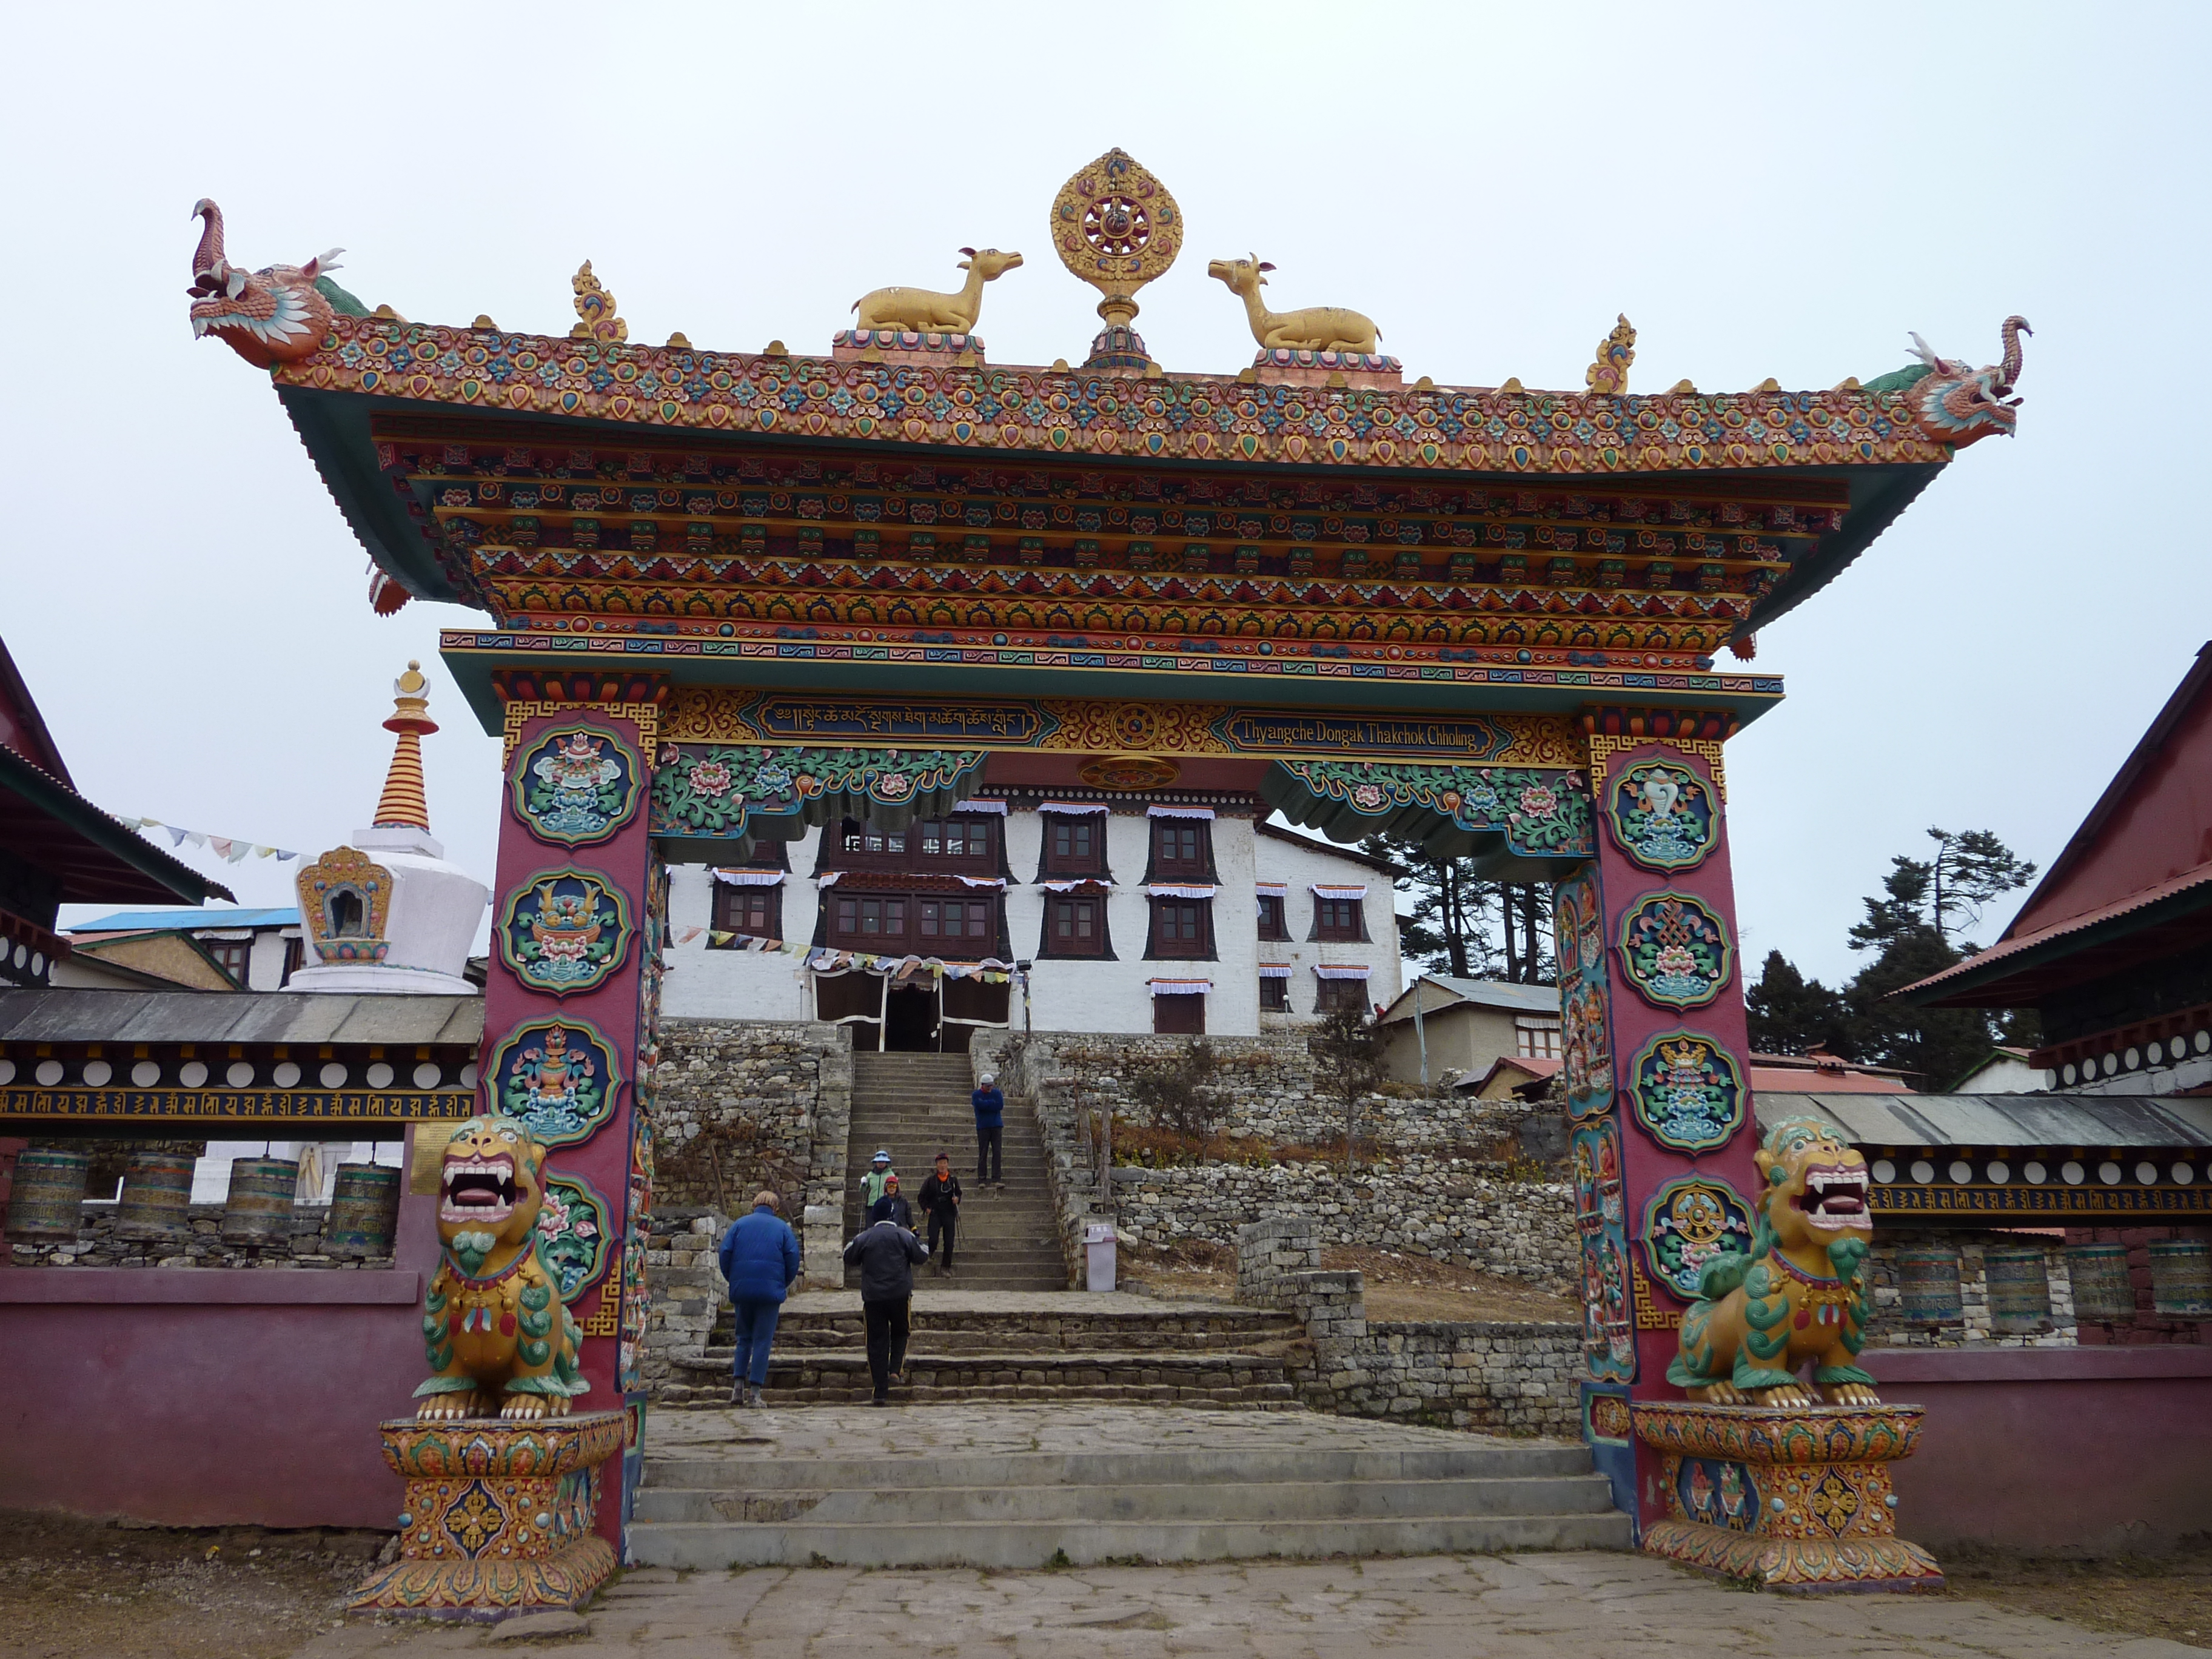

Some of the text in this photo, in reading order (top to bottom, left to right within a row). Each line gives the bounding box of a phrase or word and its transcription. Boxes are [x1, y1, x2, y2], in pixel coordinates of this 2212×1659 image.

[1241, 719, 1477, 752] Thyangche Dongak Thakchok Chholing
